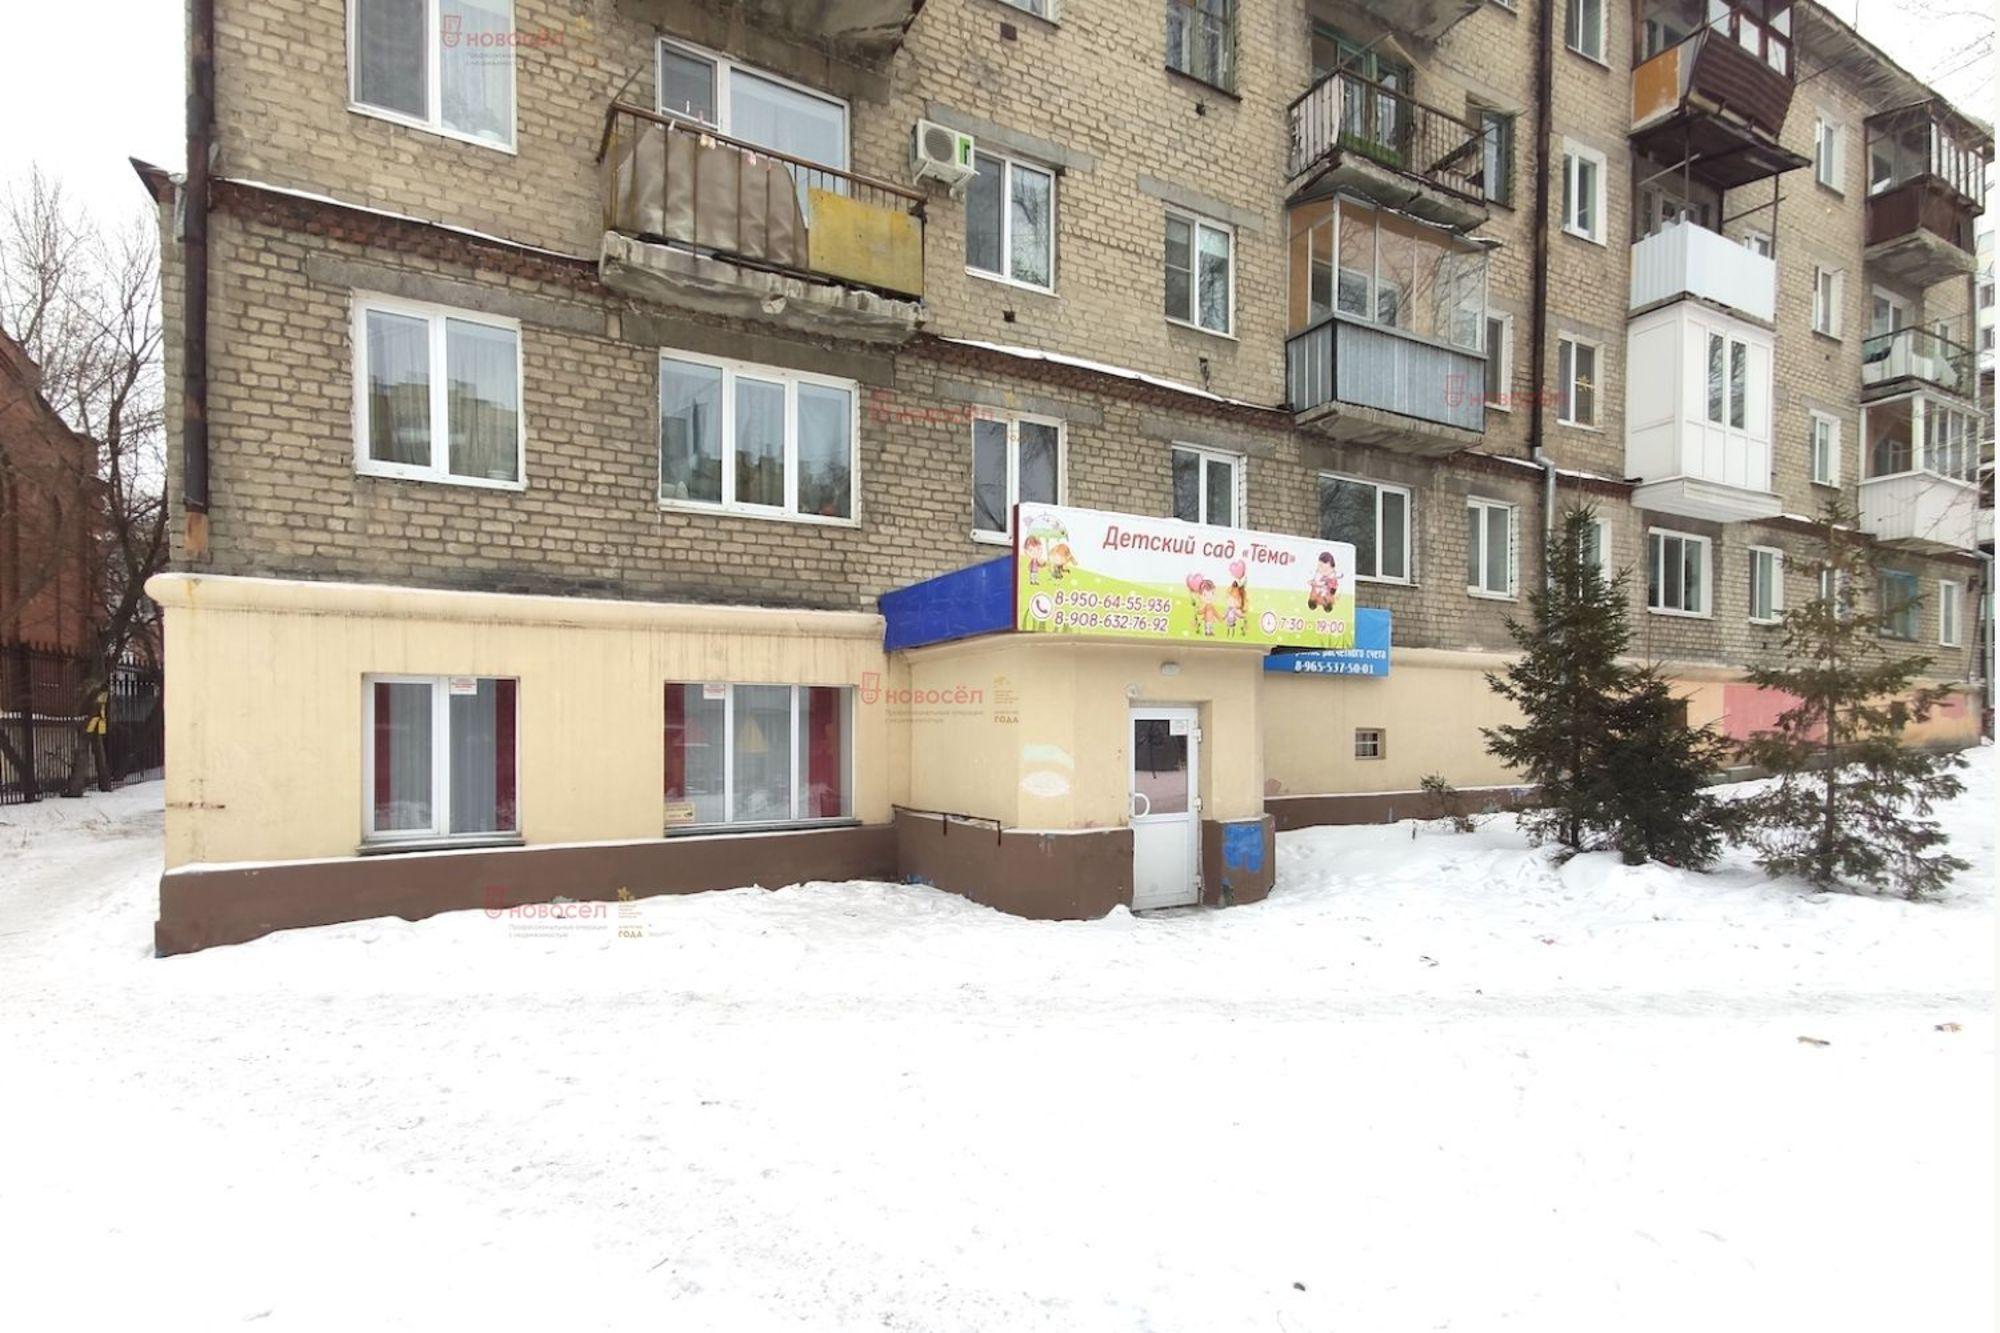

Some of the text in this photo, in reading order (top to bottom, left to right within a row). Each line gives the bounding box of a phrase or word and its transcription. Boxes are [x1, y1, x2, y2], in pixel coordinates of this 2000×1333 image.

[1103, 526, 1296, 566] Детский сад «Тёма»
[1055, 591, 1171, 613] 8-950-64-55-936
[1055, 611, 1168, 632] 8-908-632-76-92
[1281, 617, 1304, 631] 7:30
[1316, 619, 1345, 633] 19:00
[1294, 660, 1374, 675] 8-965-537-50-01
